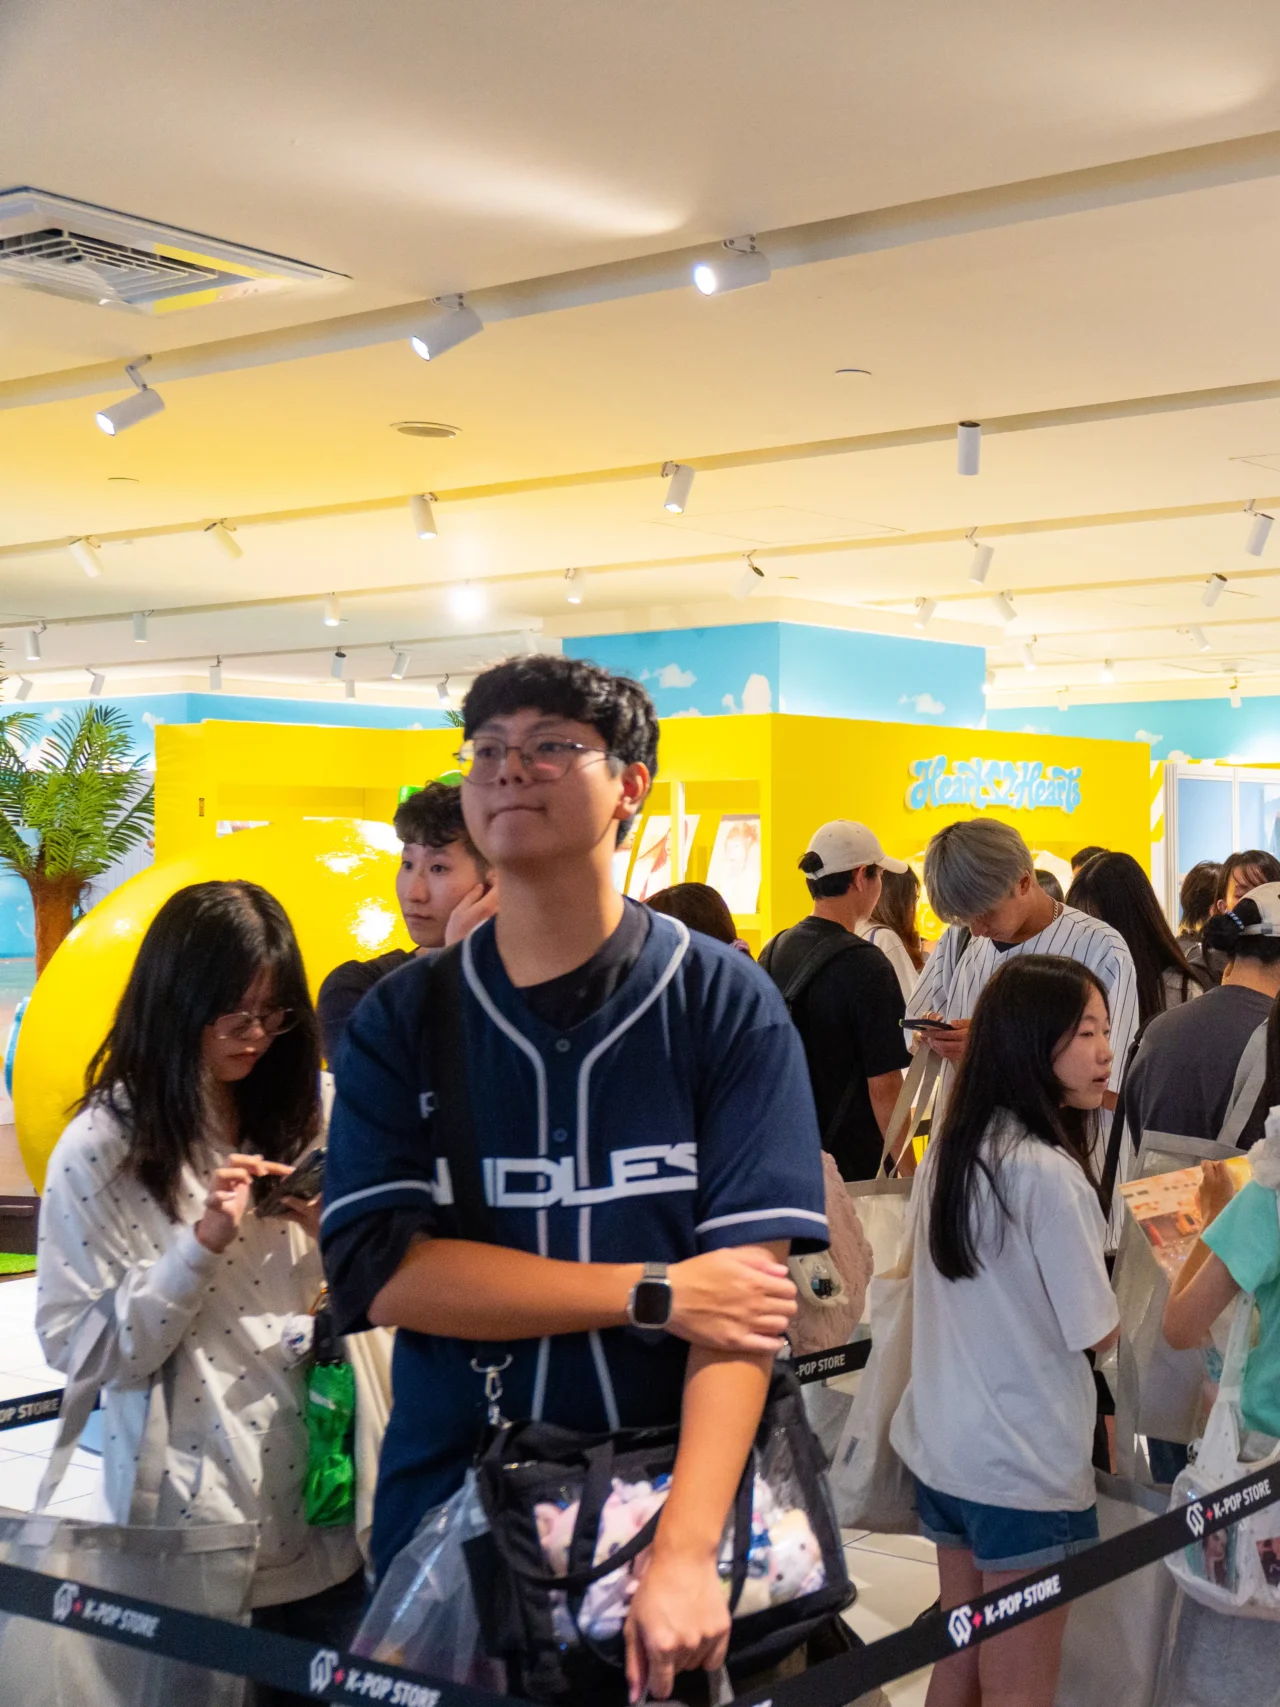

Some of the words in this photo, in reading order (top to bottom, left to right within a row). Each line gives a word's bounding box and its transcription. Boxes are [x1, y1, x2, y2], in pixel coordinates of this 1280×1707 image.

[817, 1353, 846, 1372] STORE
[17, 1398, 59, 1420] STORE
[1212, 1492, 1242, 1520] K-POP
[1242, 1479, 1272, 1506] STORE
[983, 1591, 1024, 1626] K-POP
[1023, 1573, 1062, 1608] STORE
[344, 1667, 393, 1701] K-POP
